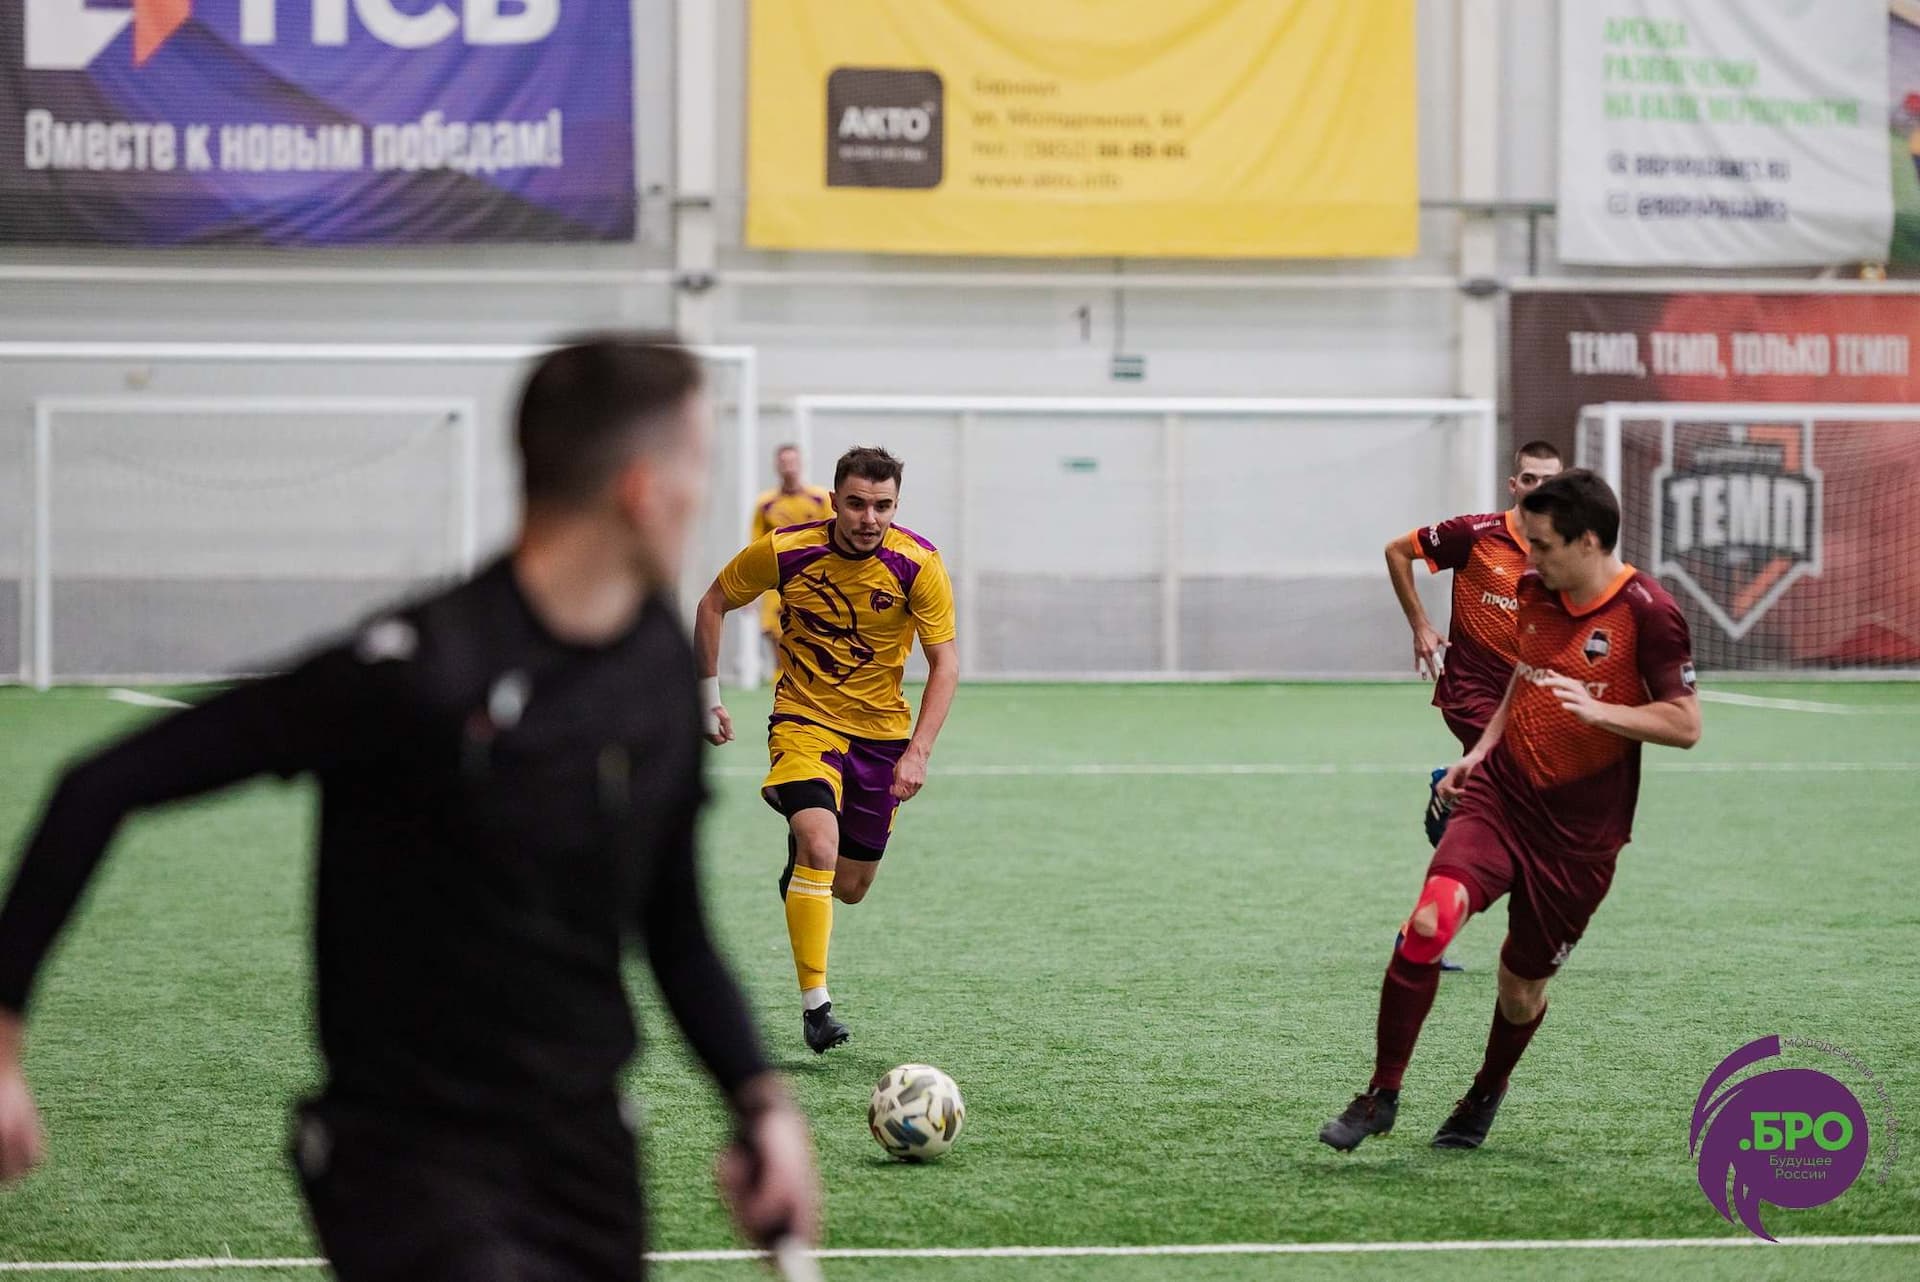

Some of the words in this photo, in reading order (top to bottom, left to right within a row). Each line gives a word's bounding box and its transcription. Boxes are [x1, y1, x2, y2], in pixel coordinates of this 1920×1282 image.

[25, 109, 176, 171] Вместе
[185, 124, 212, 171] к
[220, 124, 362, 171] новым
[372, 109, 562, 175] победам!
[1570, 332, 1646, 379] ТЕМП,
[1651, 332, 1727, 379] ТЕМП,
[1733, 333, 1830, 376] ТОЛЬКО
[1670, 473, 1808, 552] ТЕМП
